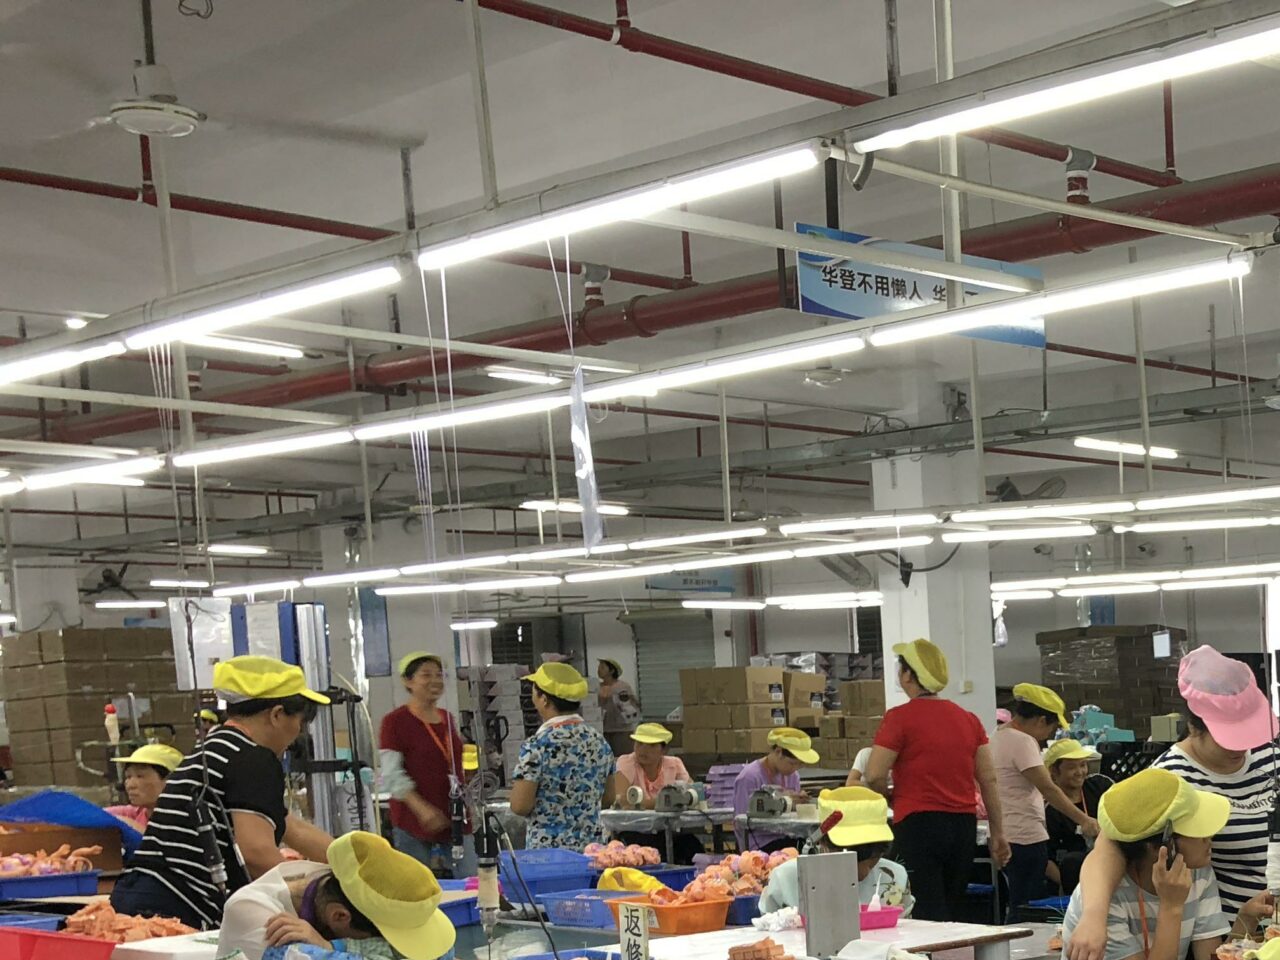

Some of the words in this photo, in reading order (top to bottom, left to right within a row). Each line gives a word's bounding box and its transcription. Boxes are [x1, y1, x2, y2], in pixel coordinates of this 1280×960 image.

[821, 265, 923, 301] 华登不用懒人
